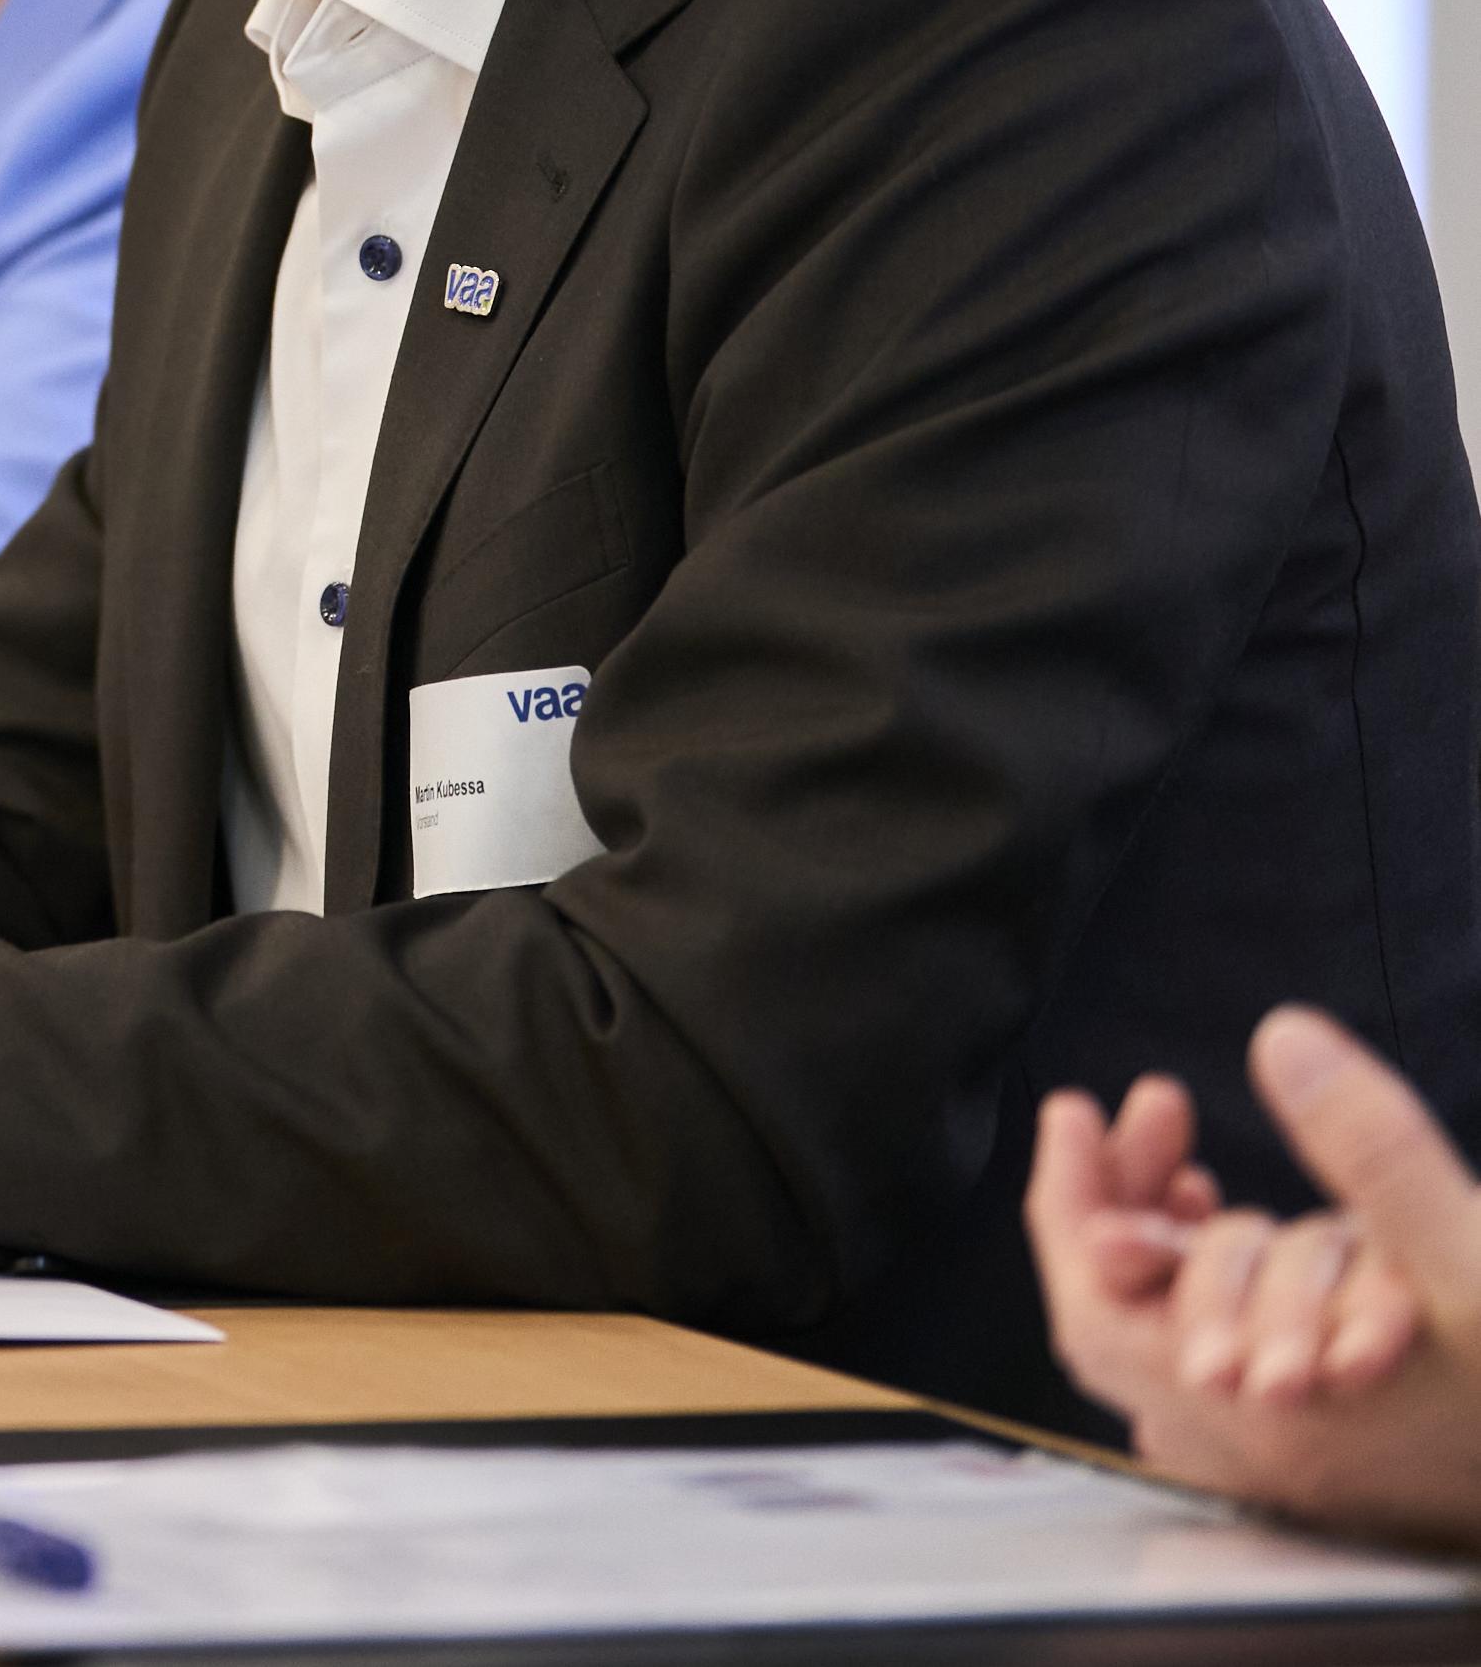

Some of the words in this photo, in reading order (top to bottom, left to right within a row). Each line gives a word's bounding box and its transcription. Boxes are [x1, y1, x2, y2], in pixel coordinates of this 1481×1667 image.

[447, 269, 495, 310] vaa
[507, 682, 587, 723] vaa
[415, 784, 435, 804] Martin
[436, 779, 485, 799] Kubessa
